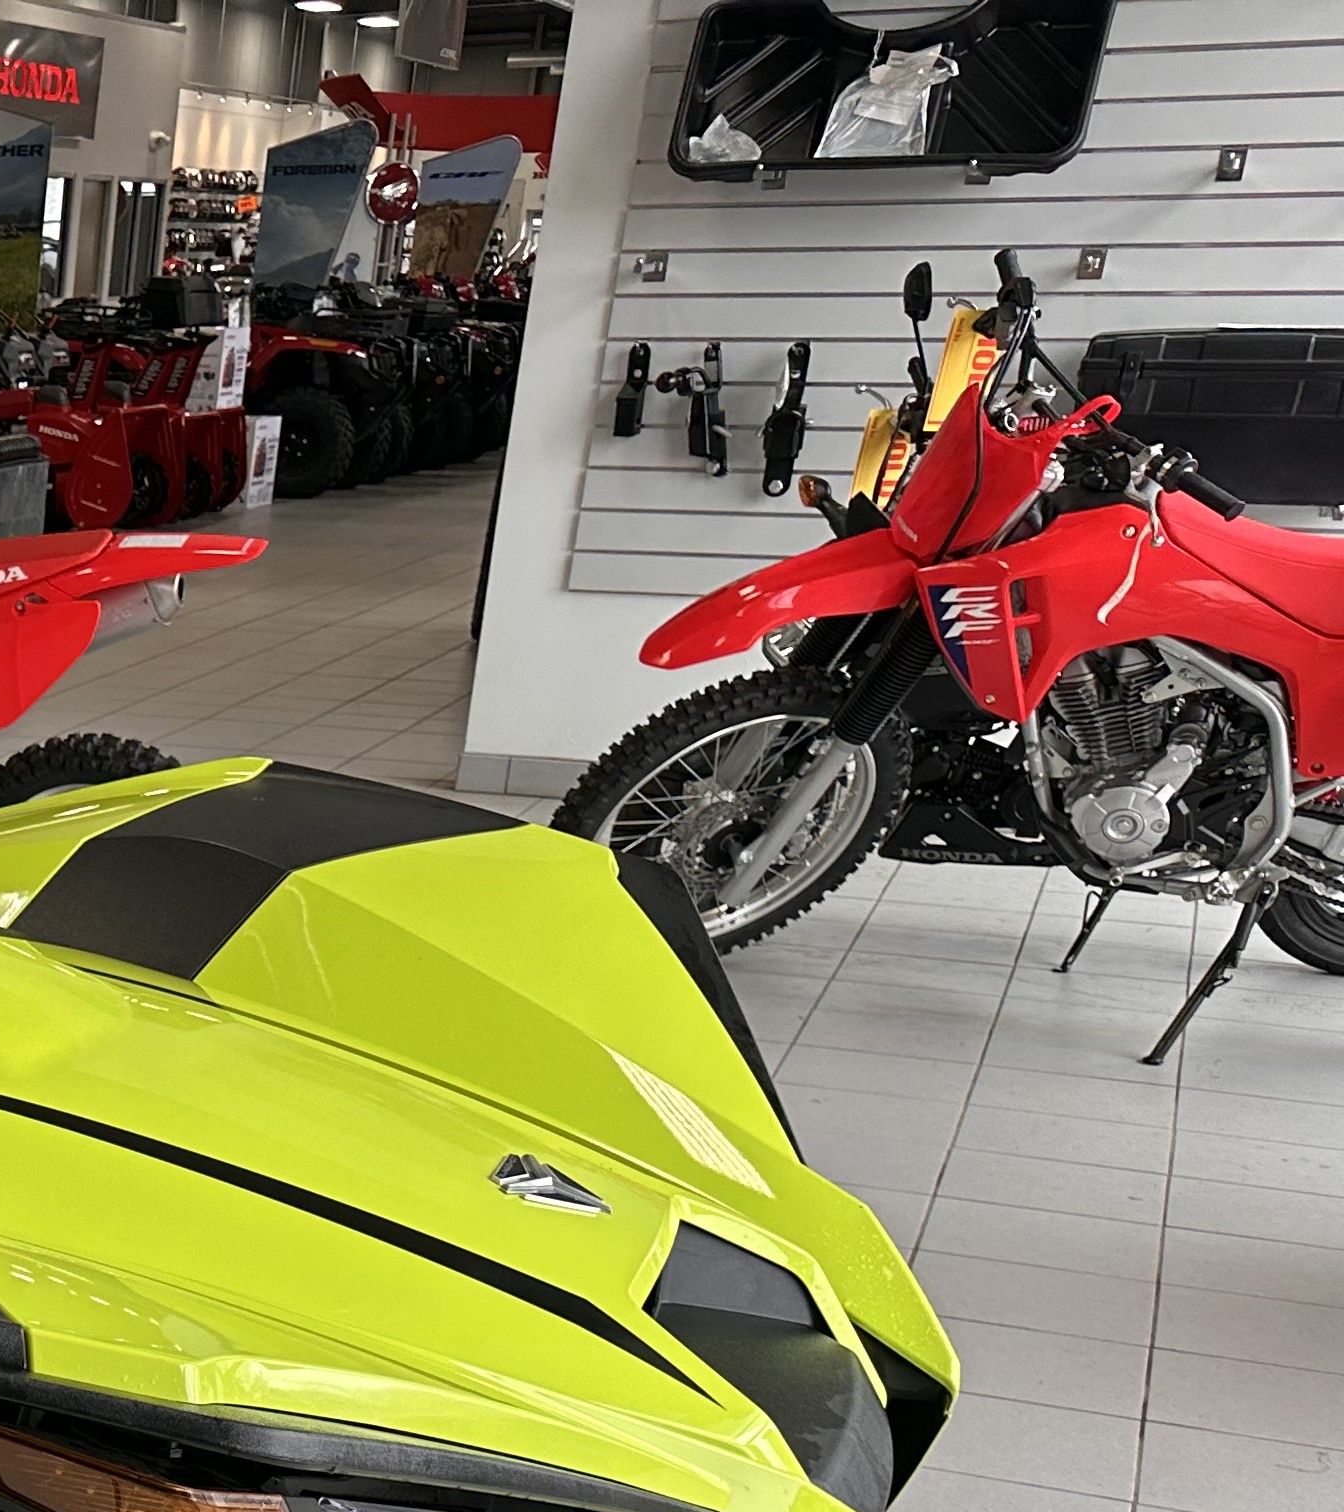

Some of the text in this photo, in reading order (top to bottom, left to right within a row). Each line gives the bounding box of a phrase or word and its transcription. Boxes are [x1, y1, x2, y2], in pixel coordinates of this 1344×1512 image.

[272, 163, 357, 176] FOREMAN
[38, 423, 80, 443] HONDA
[902, 847, 1005, 864] HONDA
